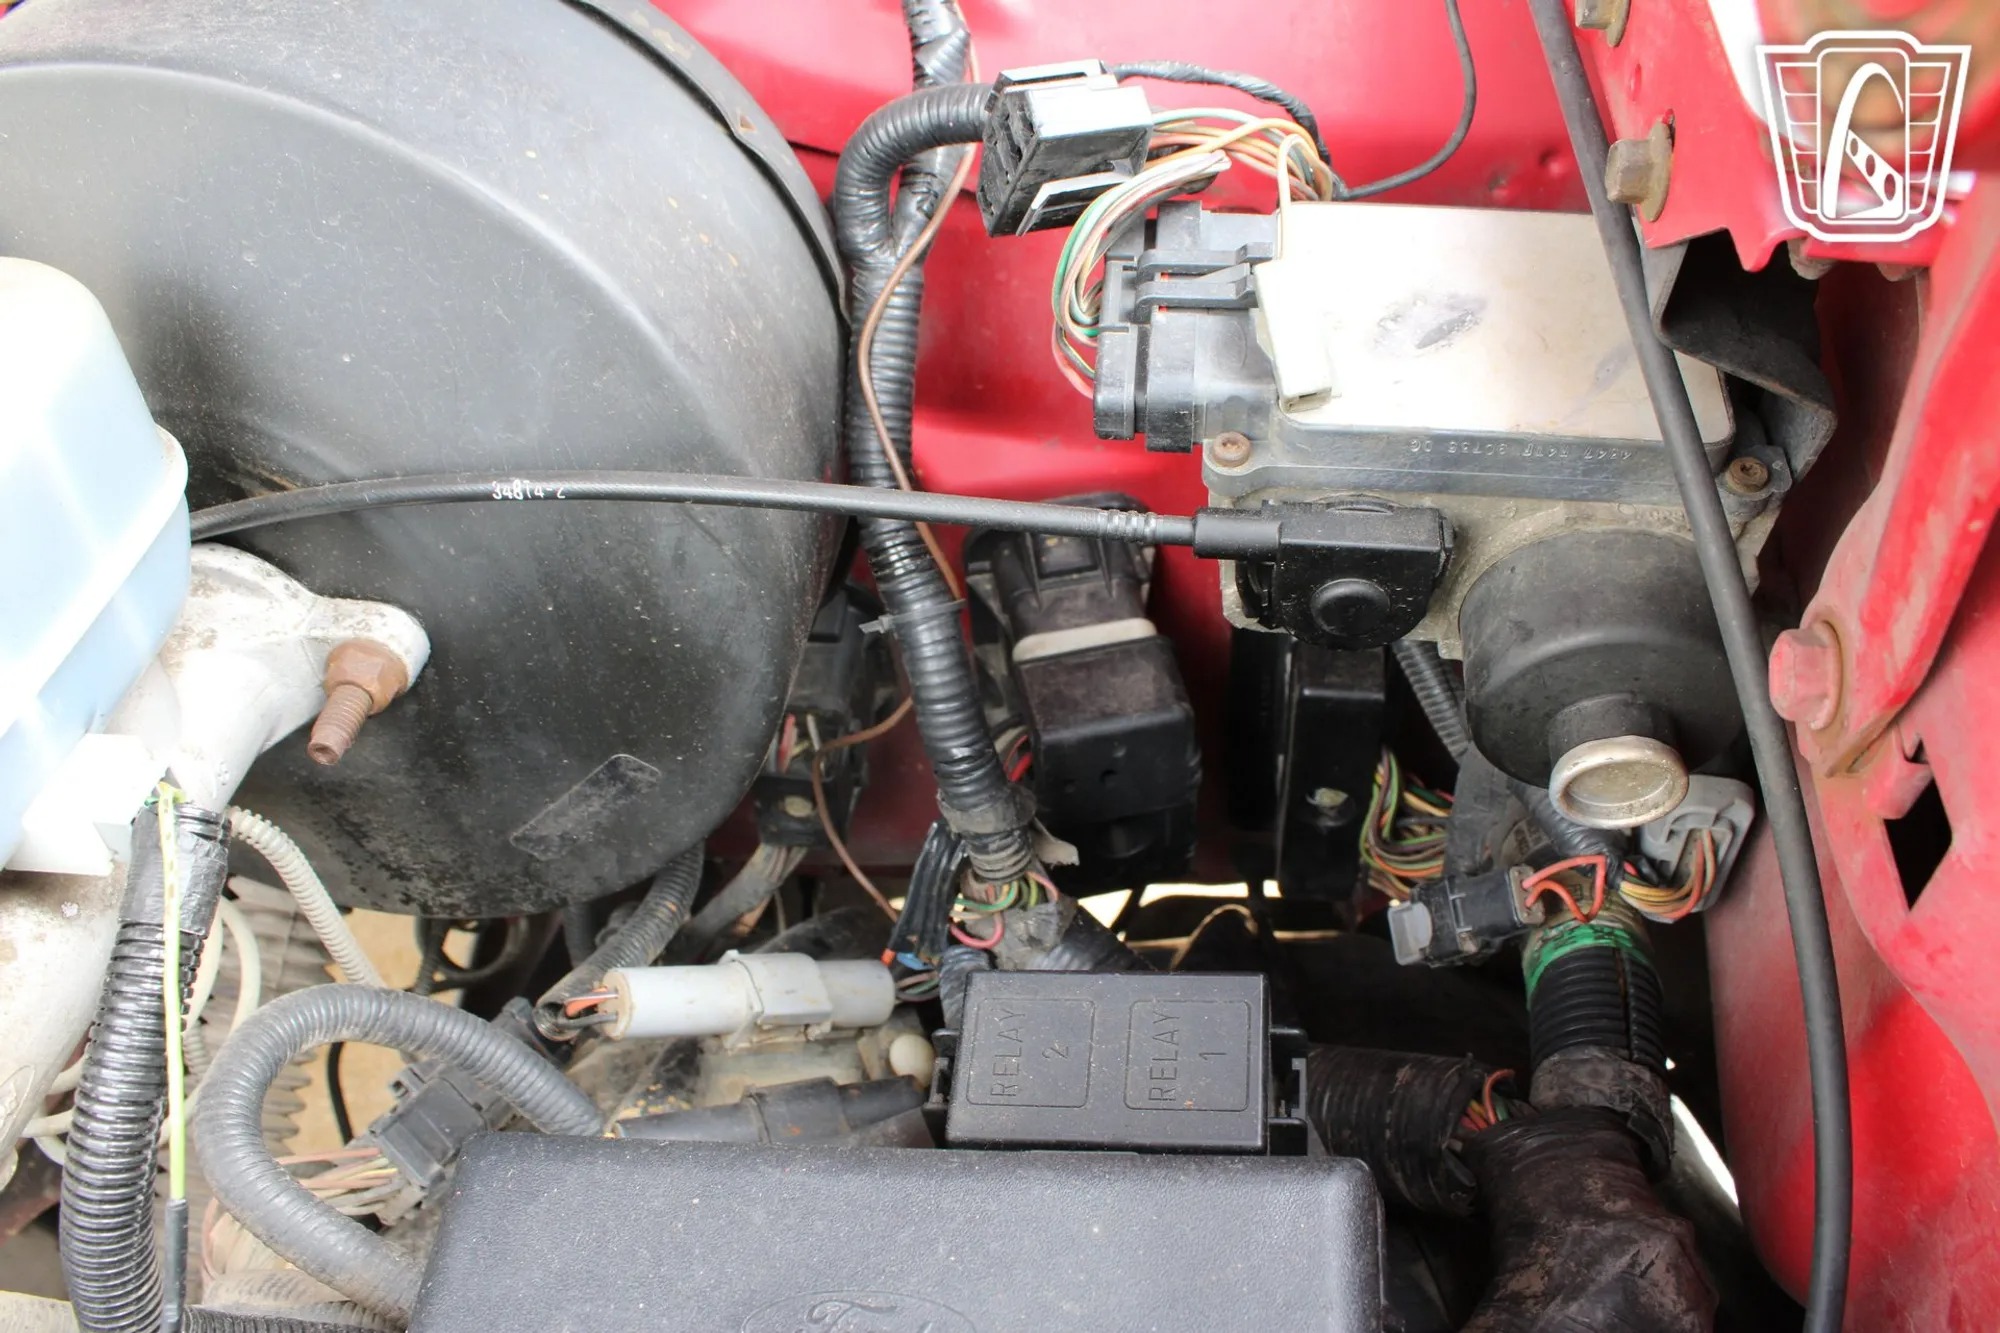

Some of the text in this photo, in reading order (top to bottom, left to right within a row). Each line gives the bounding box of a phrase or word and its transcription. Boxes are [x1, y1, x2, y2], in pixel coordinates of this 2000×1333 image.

[989, 1007, 1026, 1098] RELAY
[1040, 1045, 1069, 1061] 2
[1148, 1009, 1180, 1103] RELAY
